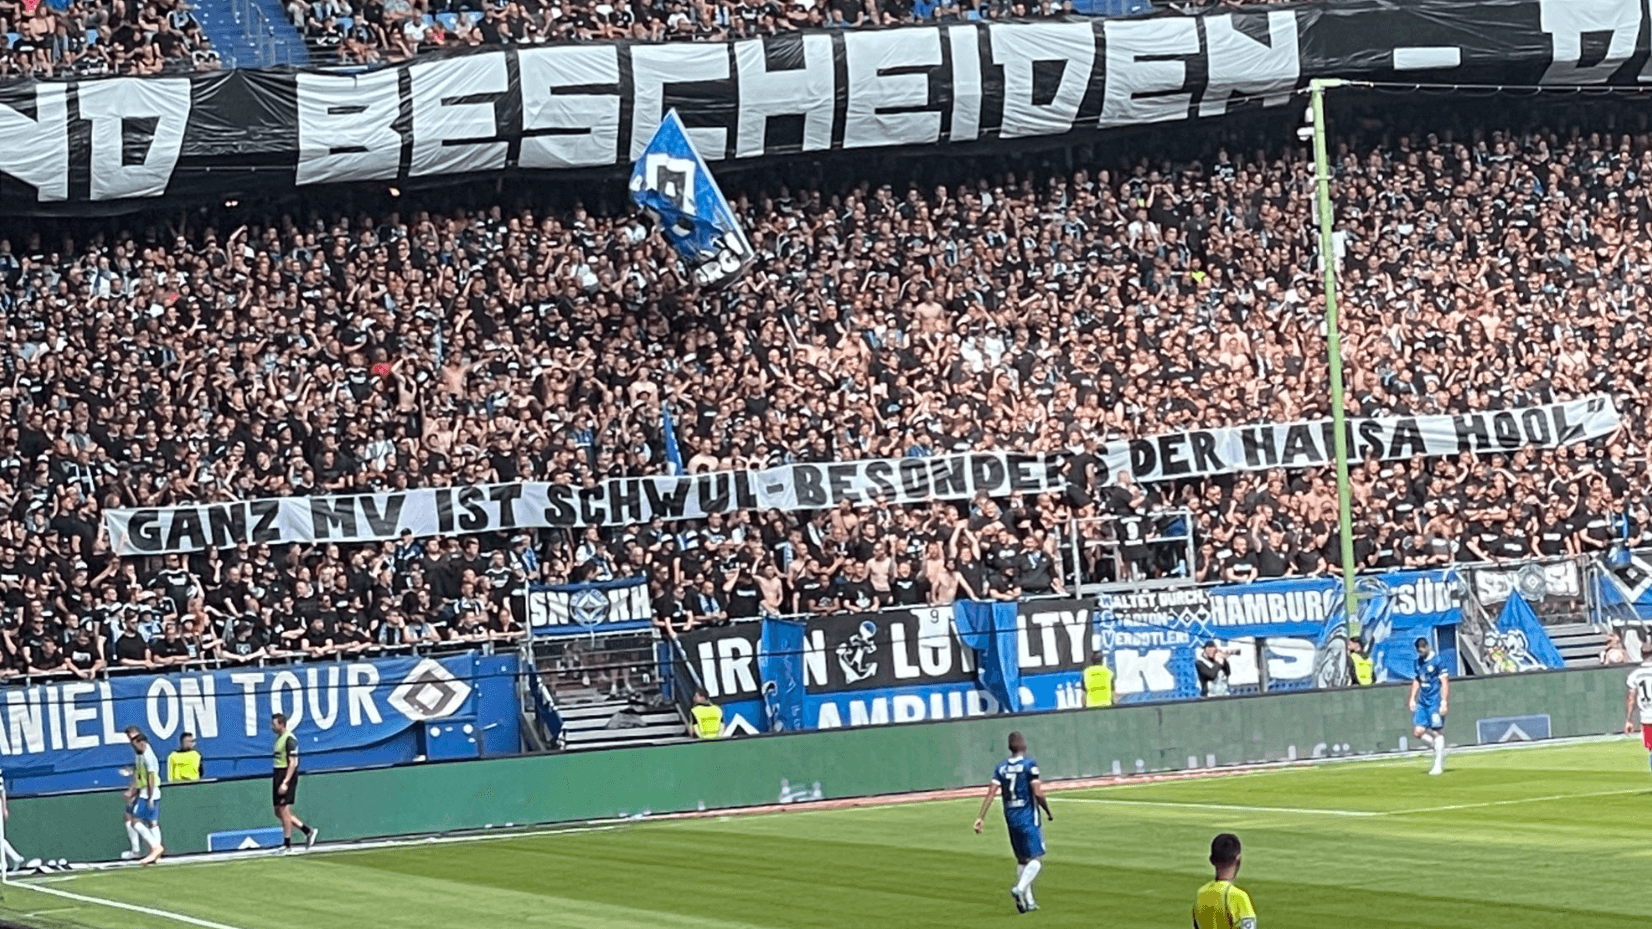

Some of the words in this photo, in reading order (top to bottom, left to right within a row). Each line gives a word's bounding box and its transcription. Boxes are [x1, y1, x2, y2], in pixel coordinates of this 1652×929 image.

[296, 10, 1301, 187] BESCHEIDEN
[1539, 0, 1652, 85] D
[127, 501, 281, 551] GANZ
[436, 485, 523, 533] IST
[1129, 431, 1221, 477] DER
[1242, 413, 1427, 467] HANSA
[929, 609, 940, 624] 9
[699, 629, 828, 697] IRN
[146, 677, 218, 740] ON
[232, 662, 384, 737] TOUR
[1005, 773, 1017, 799] 7
